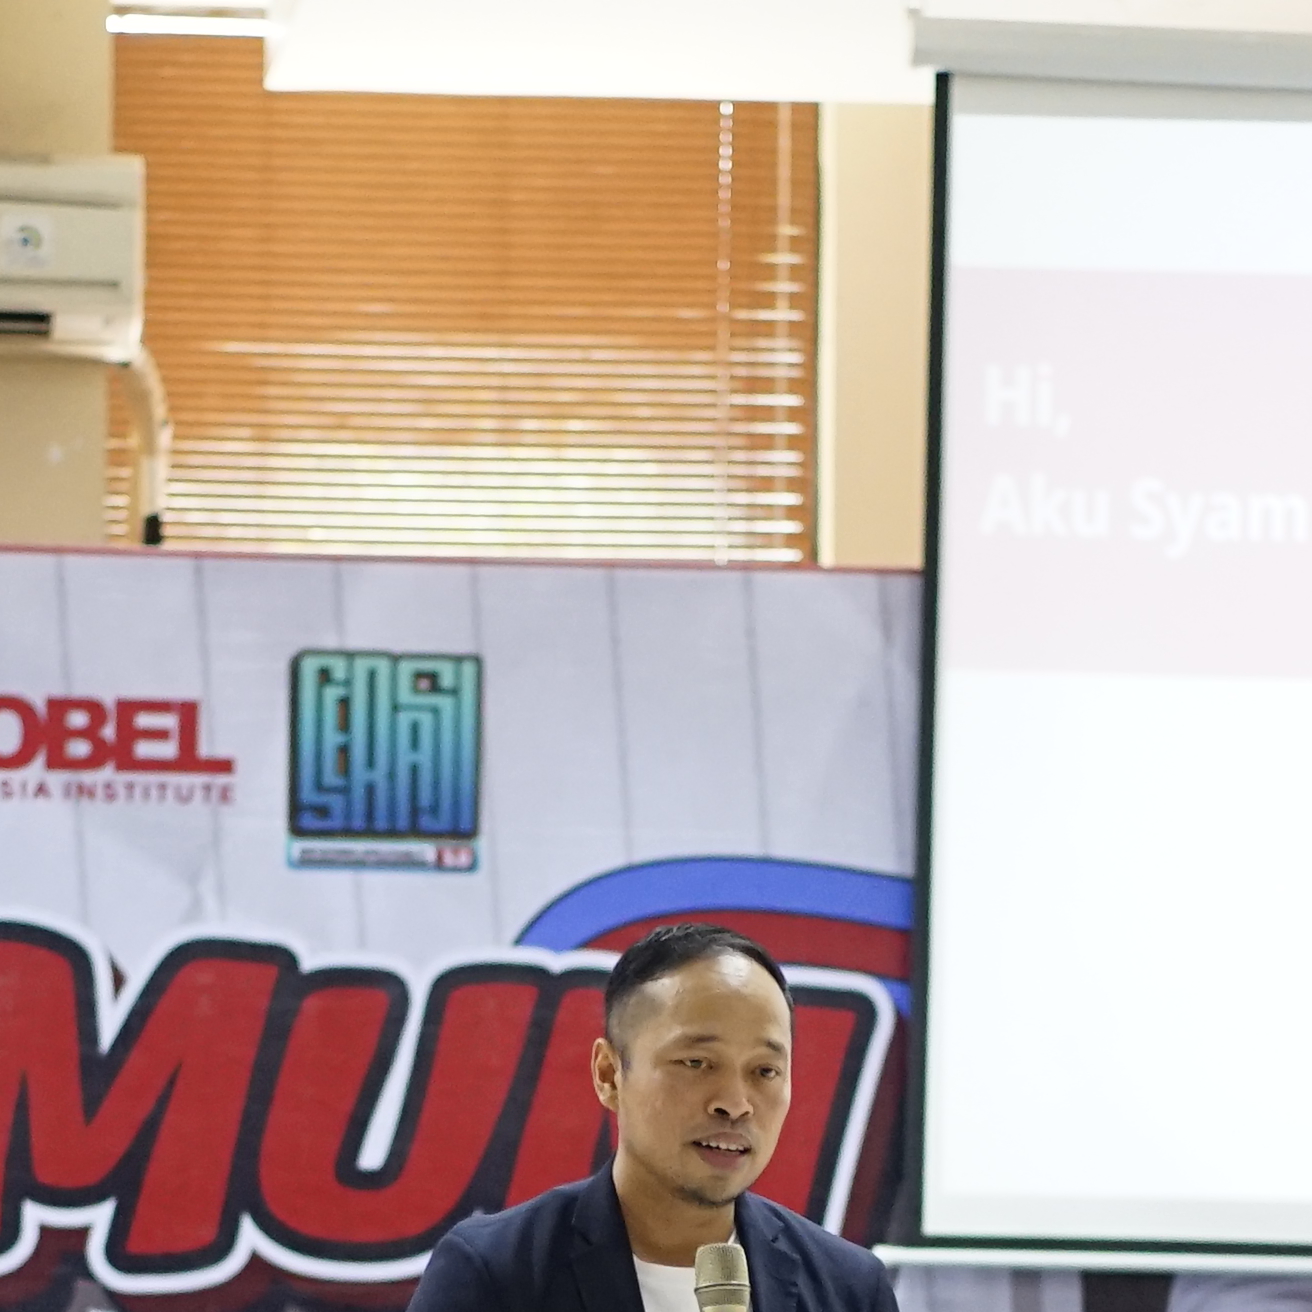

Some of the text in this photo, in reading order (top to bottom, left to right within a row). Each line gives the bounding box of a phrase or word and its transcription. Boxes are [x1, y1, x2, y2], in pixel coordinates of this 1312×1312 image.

[984, 362, 1071, 437] Hi,
[979, 472, 1310, 560] Aku Syam
[64, 779, 236, 806] INSTITUTE
